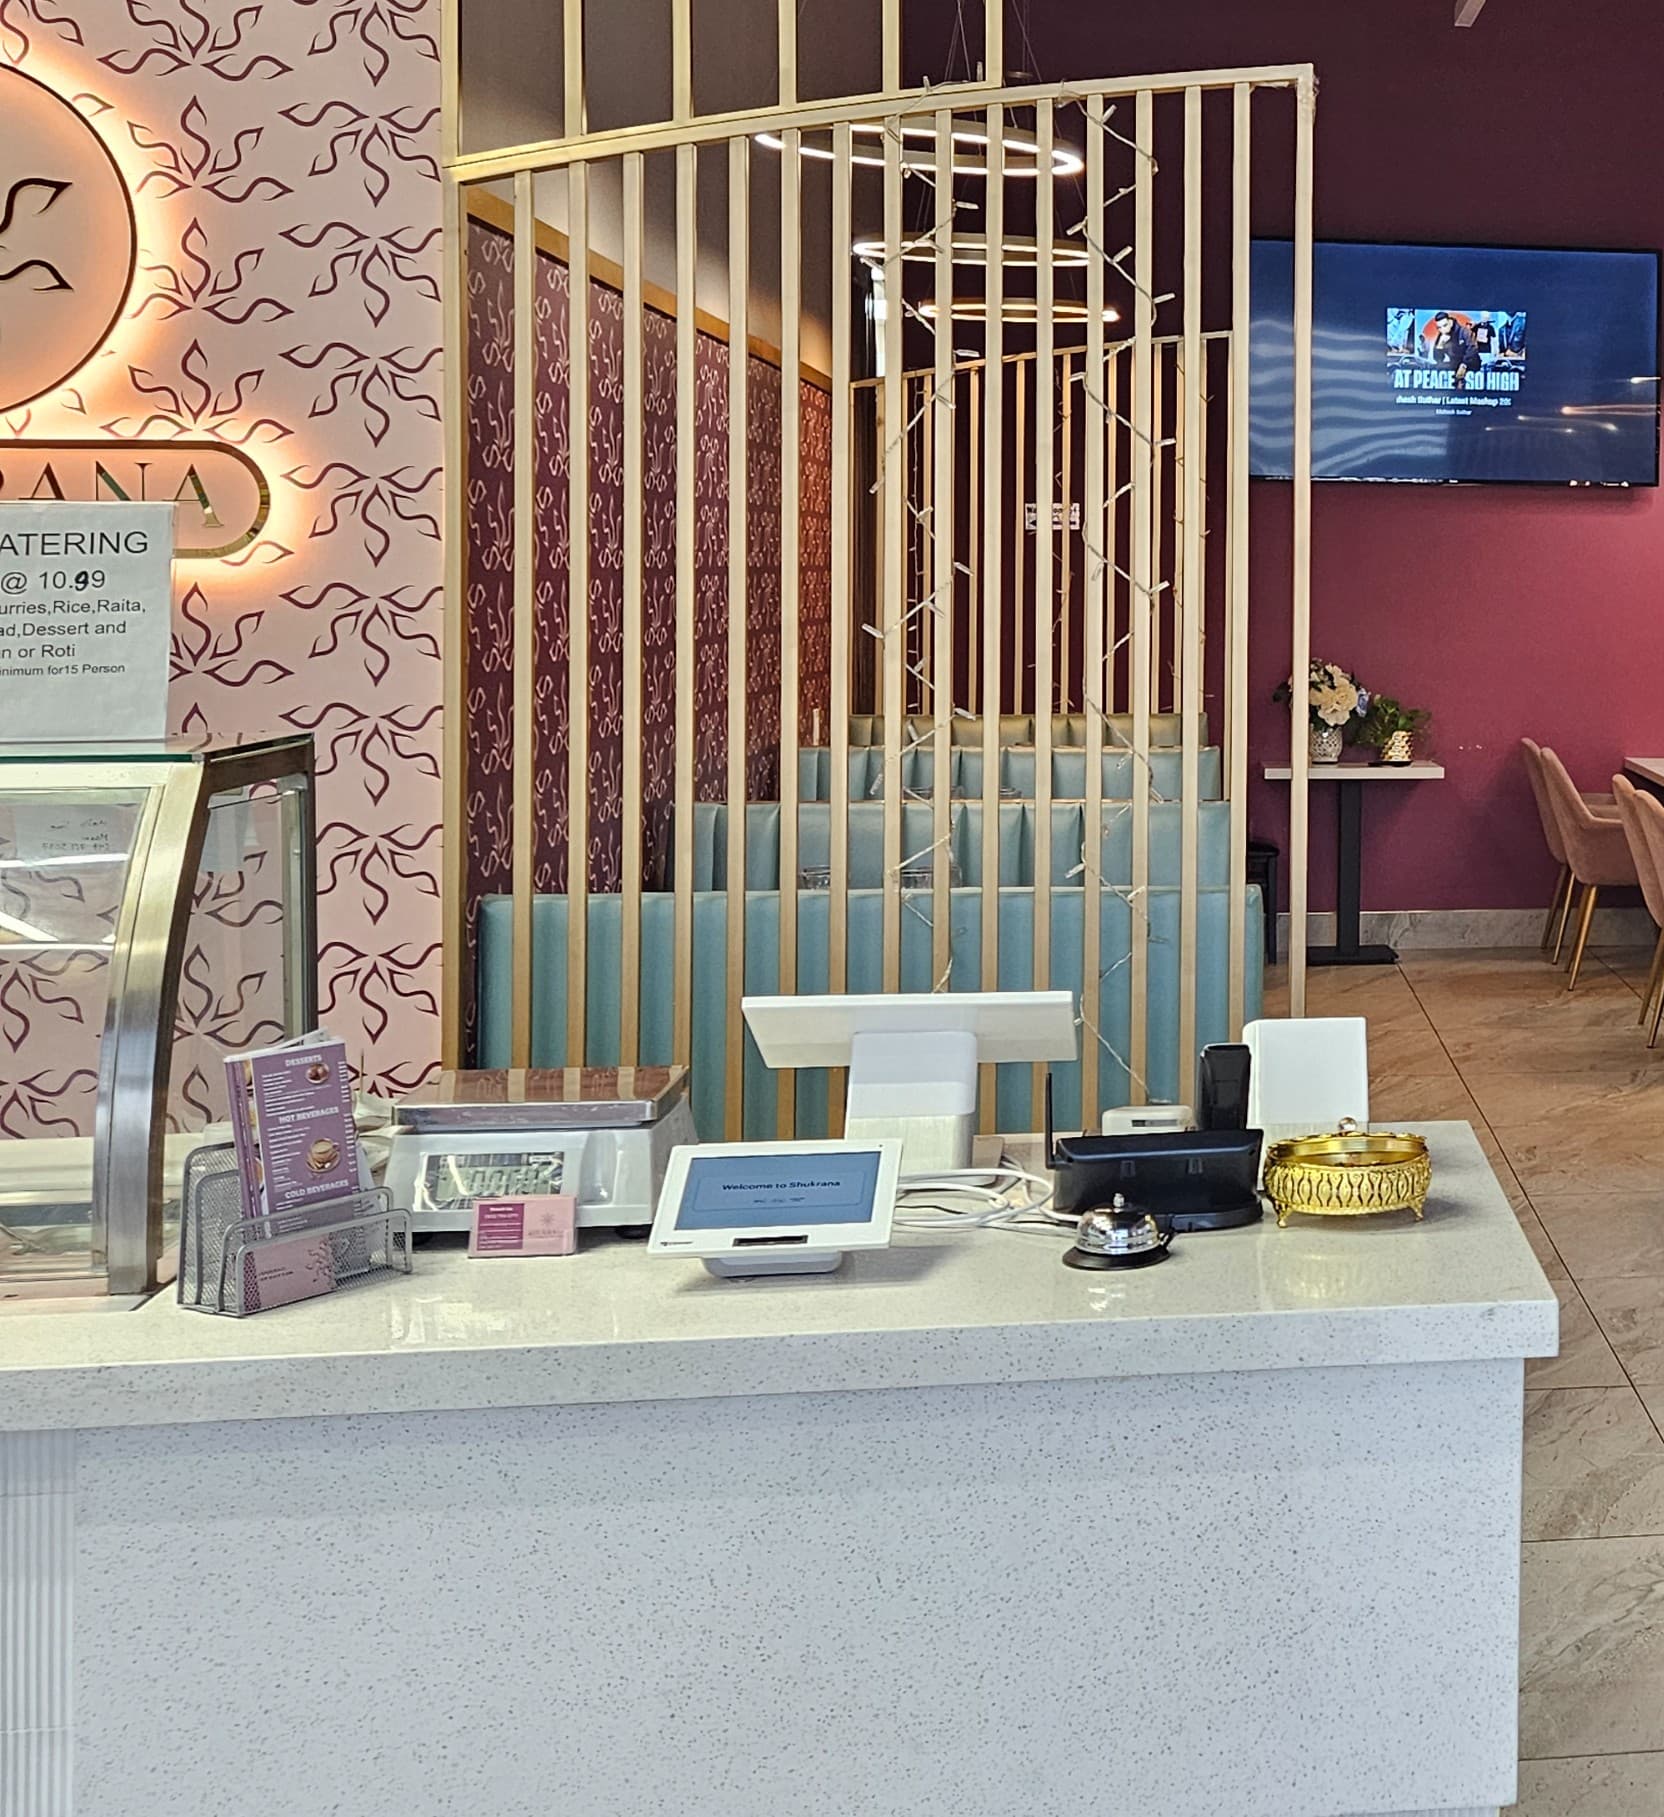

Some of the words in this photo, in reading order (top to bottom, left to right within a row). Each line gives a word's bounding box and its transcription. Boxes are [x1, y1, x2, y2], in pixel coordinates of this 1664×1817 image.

[1393, 369, 1411, 389] AT
[1412, 370, 1455, 389] PEACE
[1465, 371, 1484, 390] SO
[1486, 372, 1519, 391] HIGH
[0, 461, 224, 527] ANA
[1, 571, 27, 595] @
[39, 570, 106, 592] 10.99
[95, 620, 127, 635] and
[18, 647, 36, 658] or
[41, 643, 76, 658] Roti
[0, 666, 44, 676] nimum
[48, 664, 79, 676] for15
[82, 663, 126, 675] Person
[285, 1053, 322, 1067] DESSERTS
[279, 1114, 296, 1124] HOT
[296, 1106, 339, 1122] BEVERAGES
[284, 1188, 305, 1199] COLD
[306, 1179, 349, 1195] BEVERAGES
[788, 1180, 841, 1189] Shukrana
